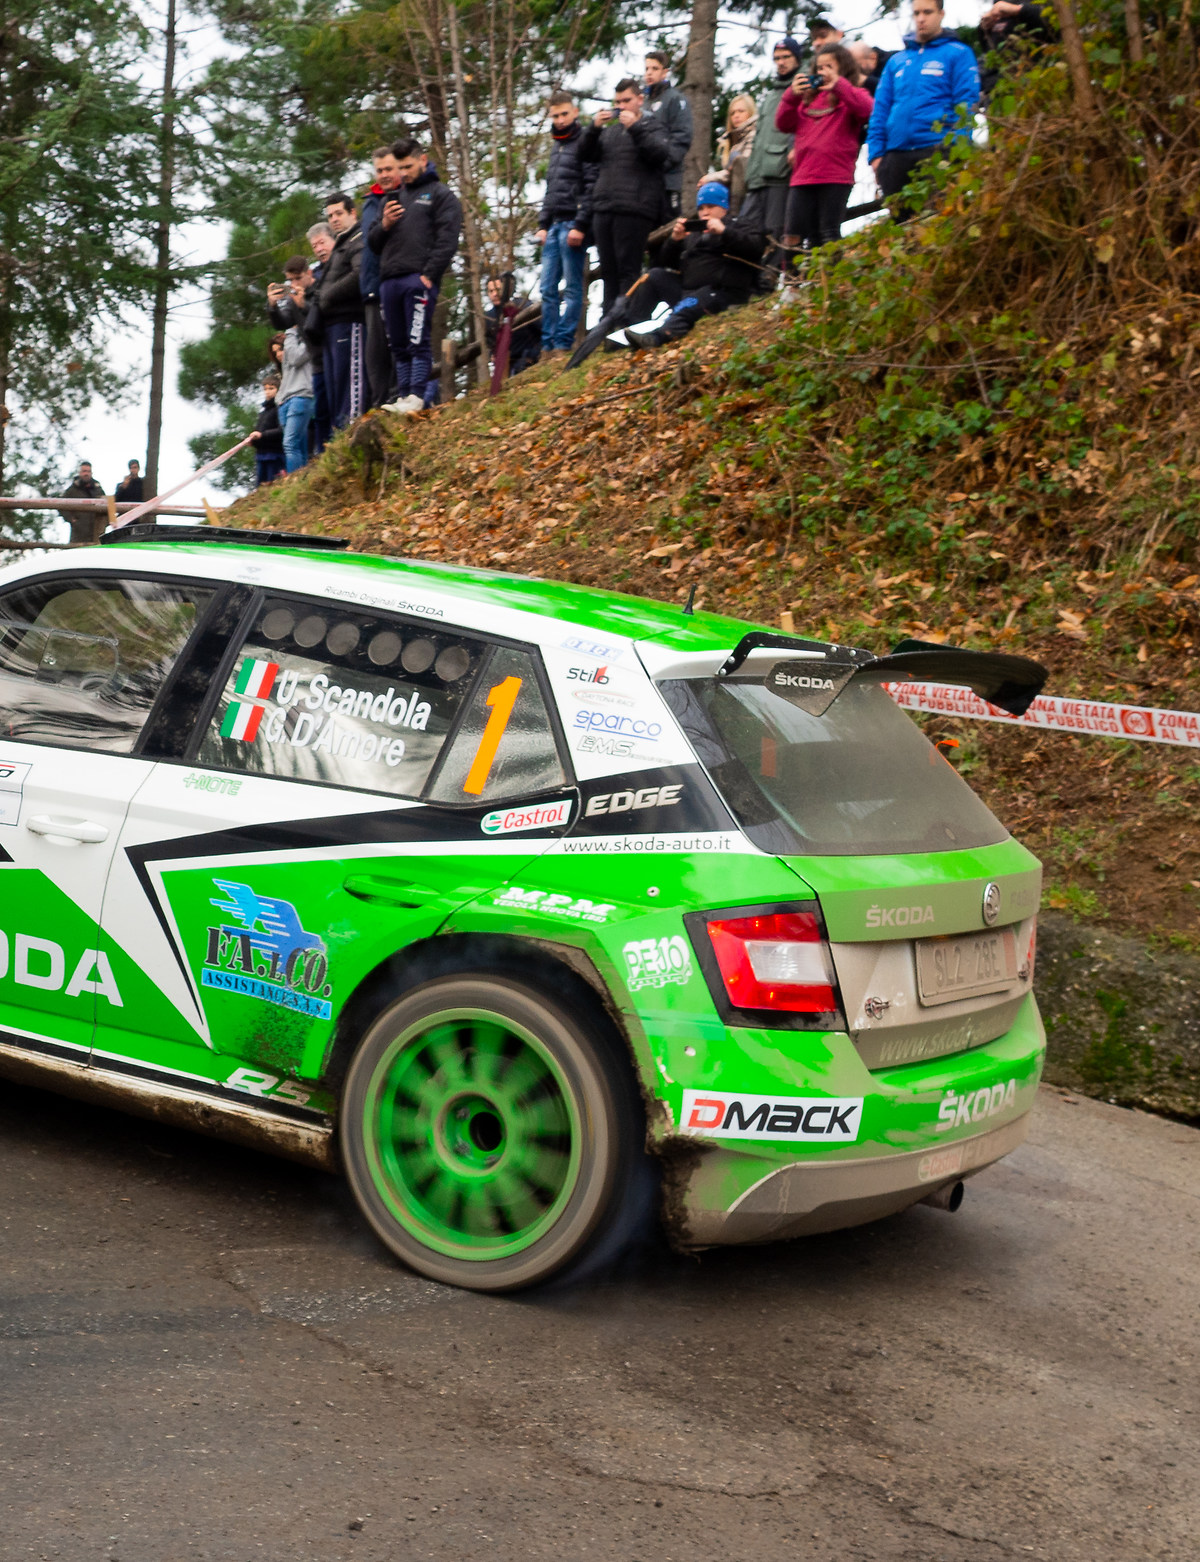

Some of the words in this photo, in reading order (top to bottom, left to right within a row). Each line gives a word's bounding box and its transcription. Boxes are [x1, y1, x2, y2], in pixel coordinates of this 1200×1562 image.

[567, 666, 609, 684] Stilo
[774, 672, 835, 690] ŠKODA
[277, 669, 300, 706] U.
[305, 673, 432, 731] Scandola
[897, 694, 912, 706] AL
[918, 696, 985, 715] PUBBLICO
[1061, 702, 1116, 720] VIETATA
[575, 710, 662, 737] sparco
[1024, 711, 1040, 723] AL
[1046, 714, 1119, 733] PUBBLICO
[1158, 713, 1198, 730] ZONA
[265, 706, 287, 744] G.
[290, 711, 406, 767] D'Amore
[463, 675, 523, 795] 1
[1161, 728, 1180, 741] AL
[585, 784, 684, 818] EDGE
[503, 804, 564, 830] Castrol
[563, 836, 732, 853] www.skoda-auto.it
[865, 904, 935, 928] ŠKODA
[687, 1098, 858, 1134] DMACK
[935, 1078, 1016, 1133] ŠKODA
